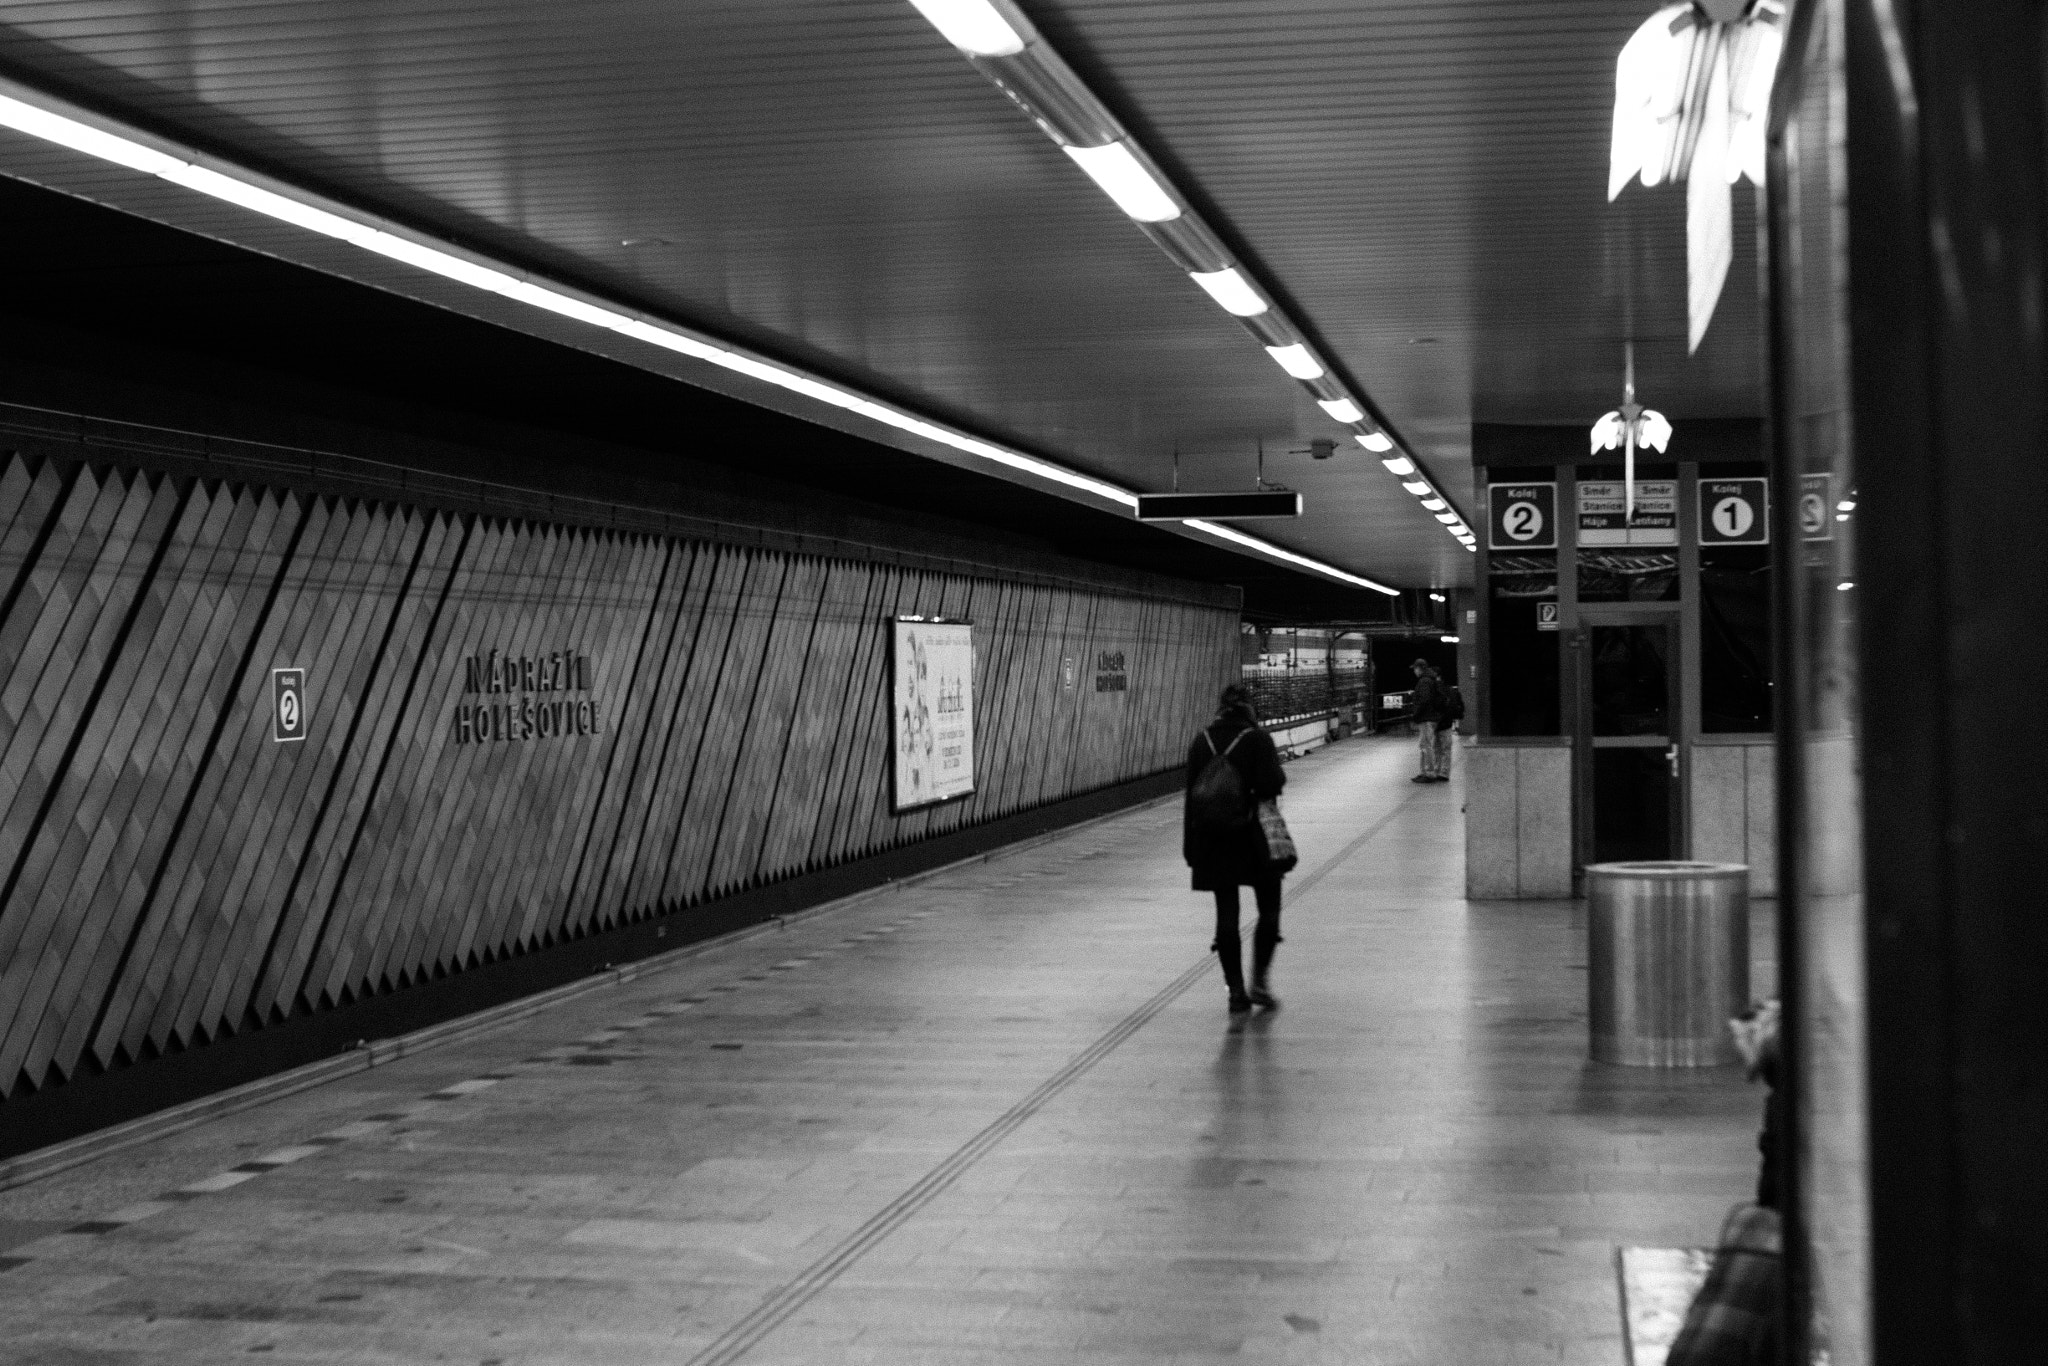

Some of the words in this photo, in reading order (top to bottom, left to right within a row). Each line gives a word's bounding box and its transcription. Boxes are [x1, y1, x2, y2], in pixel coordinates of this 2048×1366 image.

[1508, 489, 1536, 498] Kolej
[1712, 485, 1741, 494] Kolej
[1582, 502, 1622, 511] Stanice
[1634, 502, 1670, 510] tanice
[1513, 506, 1533, 534] 2
[1723, 502, 1736, 530] 1
[285, 696, 293, 724] 2
[454, 698, 600, 744] HOLEŠOVICE
